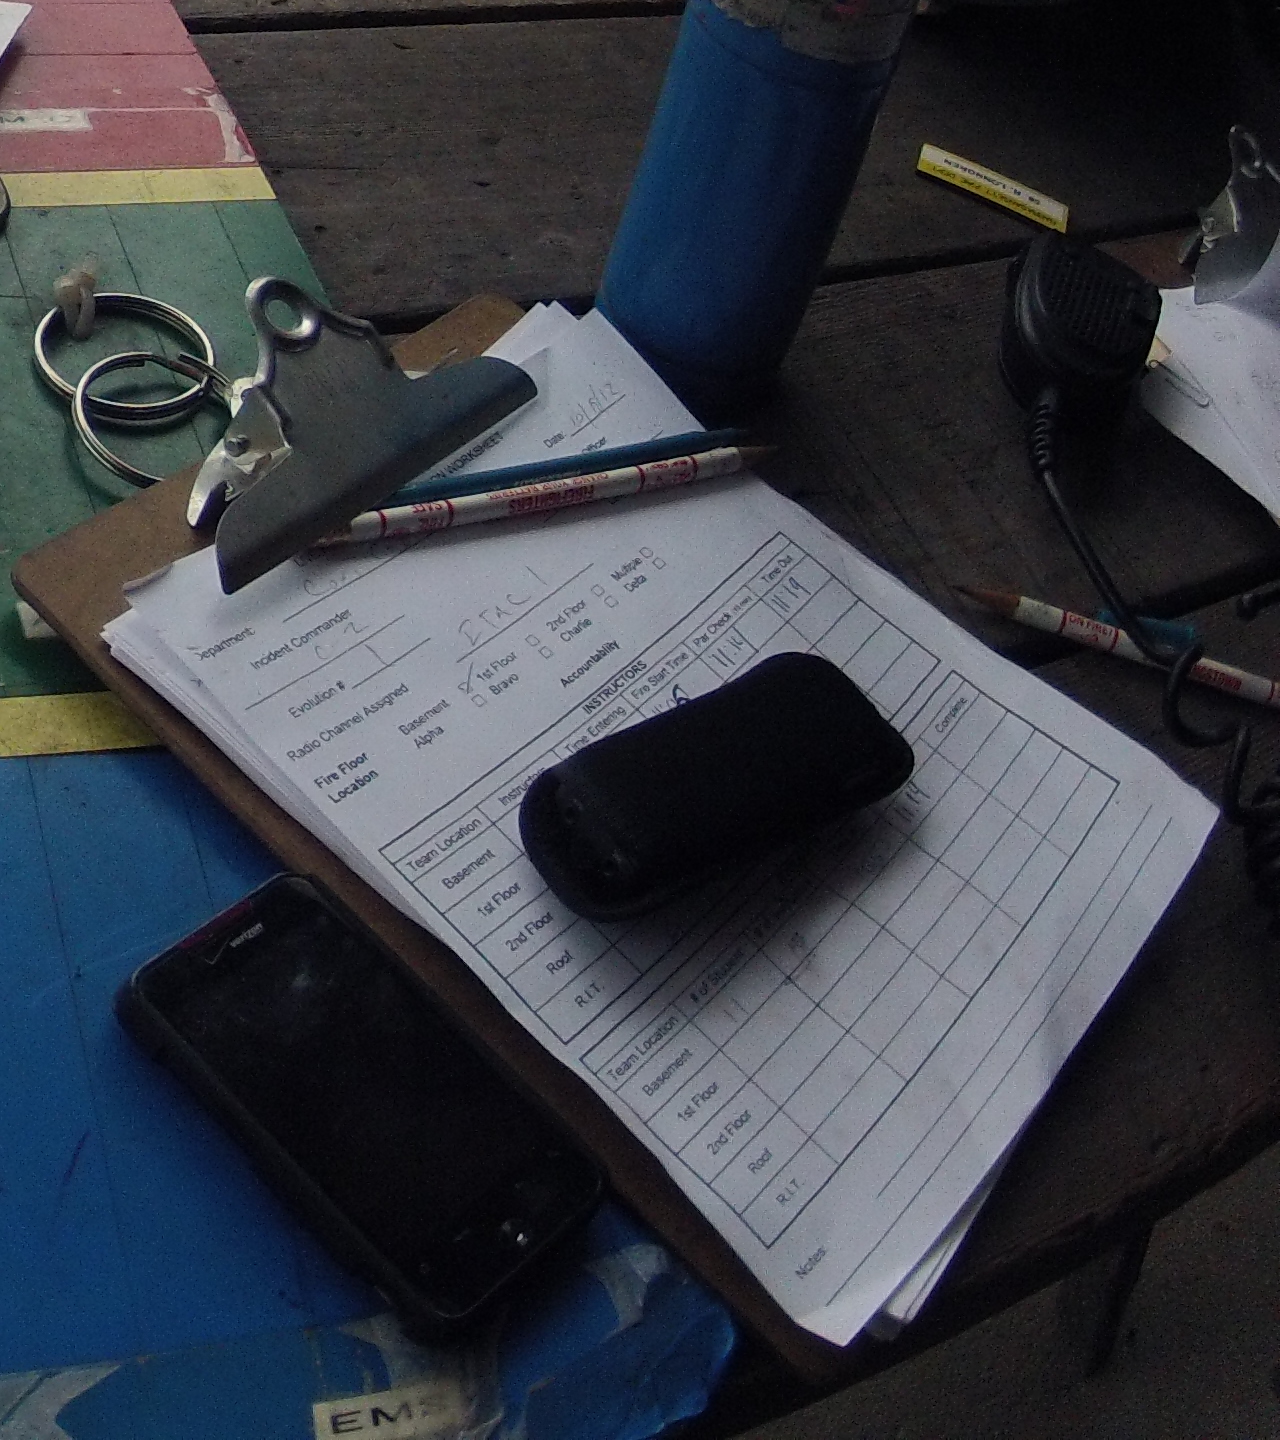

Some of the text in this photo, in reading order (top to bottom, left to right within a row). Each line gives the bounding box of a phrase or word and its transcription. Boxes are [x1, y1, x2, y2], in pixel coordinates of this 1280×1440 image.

[445, 431, 504, 474] WORKSHEET
[508, 484, 595, 512] FIREFIGHTERS
[609, 557, 643, 582] Multiple
[622, 574, 648, 593] Delta
[760, 554, 794, 583] Time Out
[545, 599, 588, 633] 2nd Floor
[559, 618, 594, 643] Charlie
[692, 612, 732, 647] Par Check
[249, 609, 352, 670] Incident Commander
[476, 650, 519, 683] 1st Floor
[560, 639, 621, 689] Accountability
[630, 650, 690, 700] Fire Start Time
[488, 672, 520, 695] Bravo
[582, 659, 648, 715] INSTRUCTORS
[287, 686, 338, 719] Evolution
[397, 698, 451, 736] Basement
[286, 682, 410, 762] Radio Channel Assigned
[413, 726, 445, 749] Alpha
[563, 706, 627, 755] Time Entering
[313, 751, 369, 790] Fire Floor
[327, 768, 380, 804] Location
[405, 817, 483, 872] Team Location
[440, 847, 497, 891] Basement
[476, 881, 522, 918] 1st Floor
[228, 921, 266, 949] verizon
[504, 910, 555, 953] 2nd Floor
[545, 949, 574, 975] Roof
[698, 980, 710, 996] of
[605, 1015, 680, 1082] Team Location
[641, 1047, 694, 1098] Basement
[676, 1081, 721, 1123] 1st Floor
[706, 1109, 752, 1156] 2nd Floor
[747, 1147, 773, 1175] Roof
